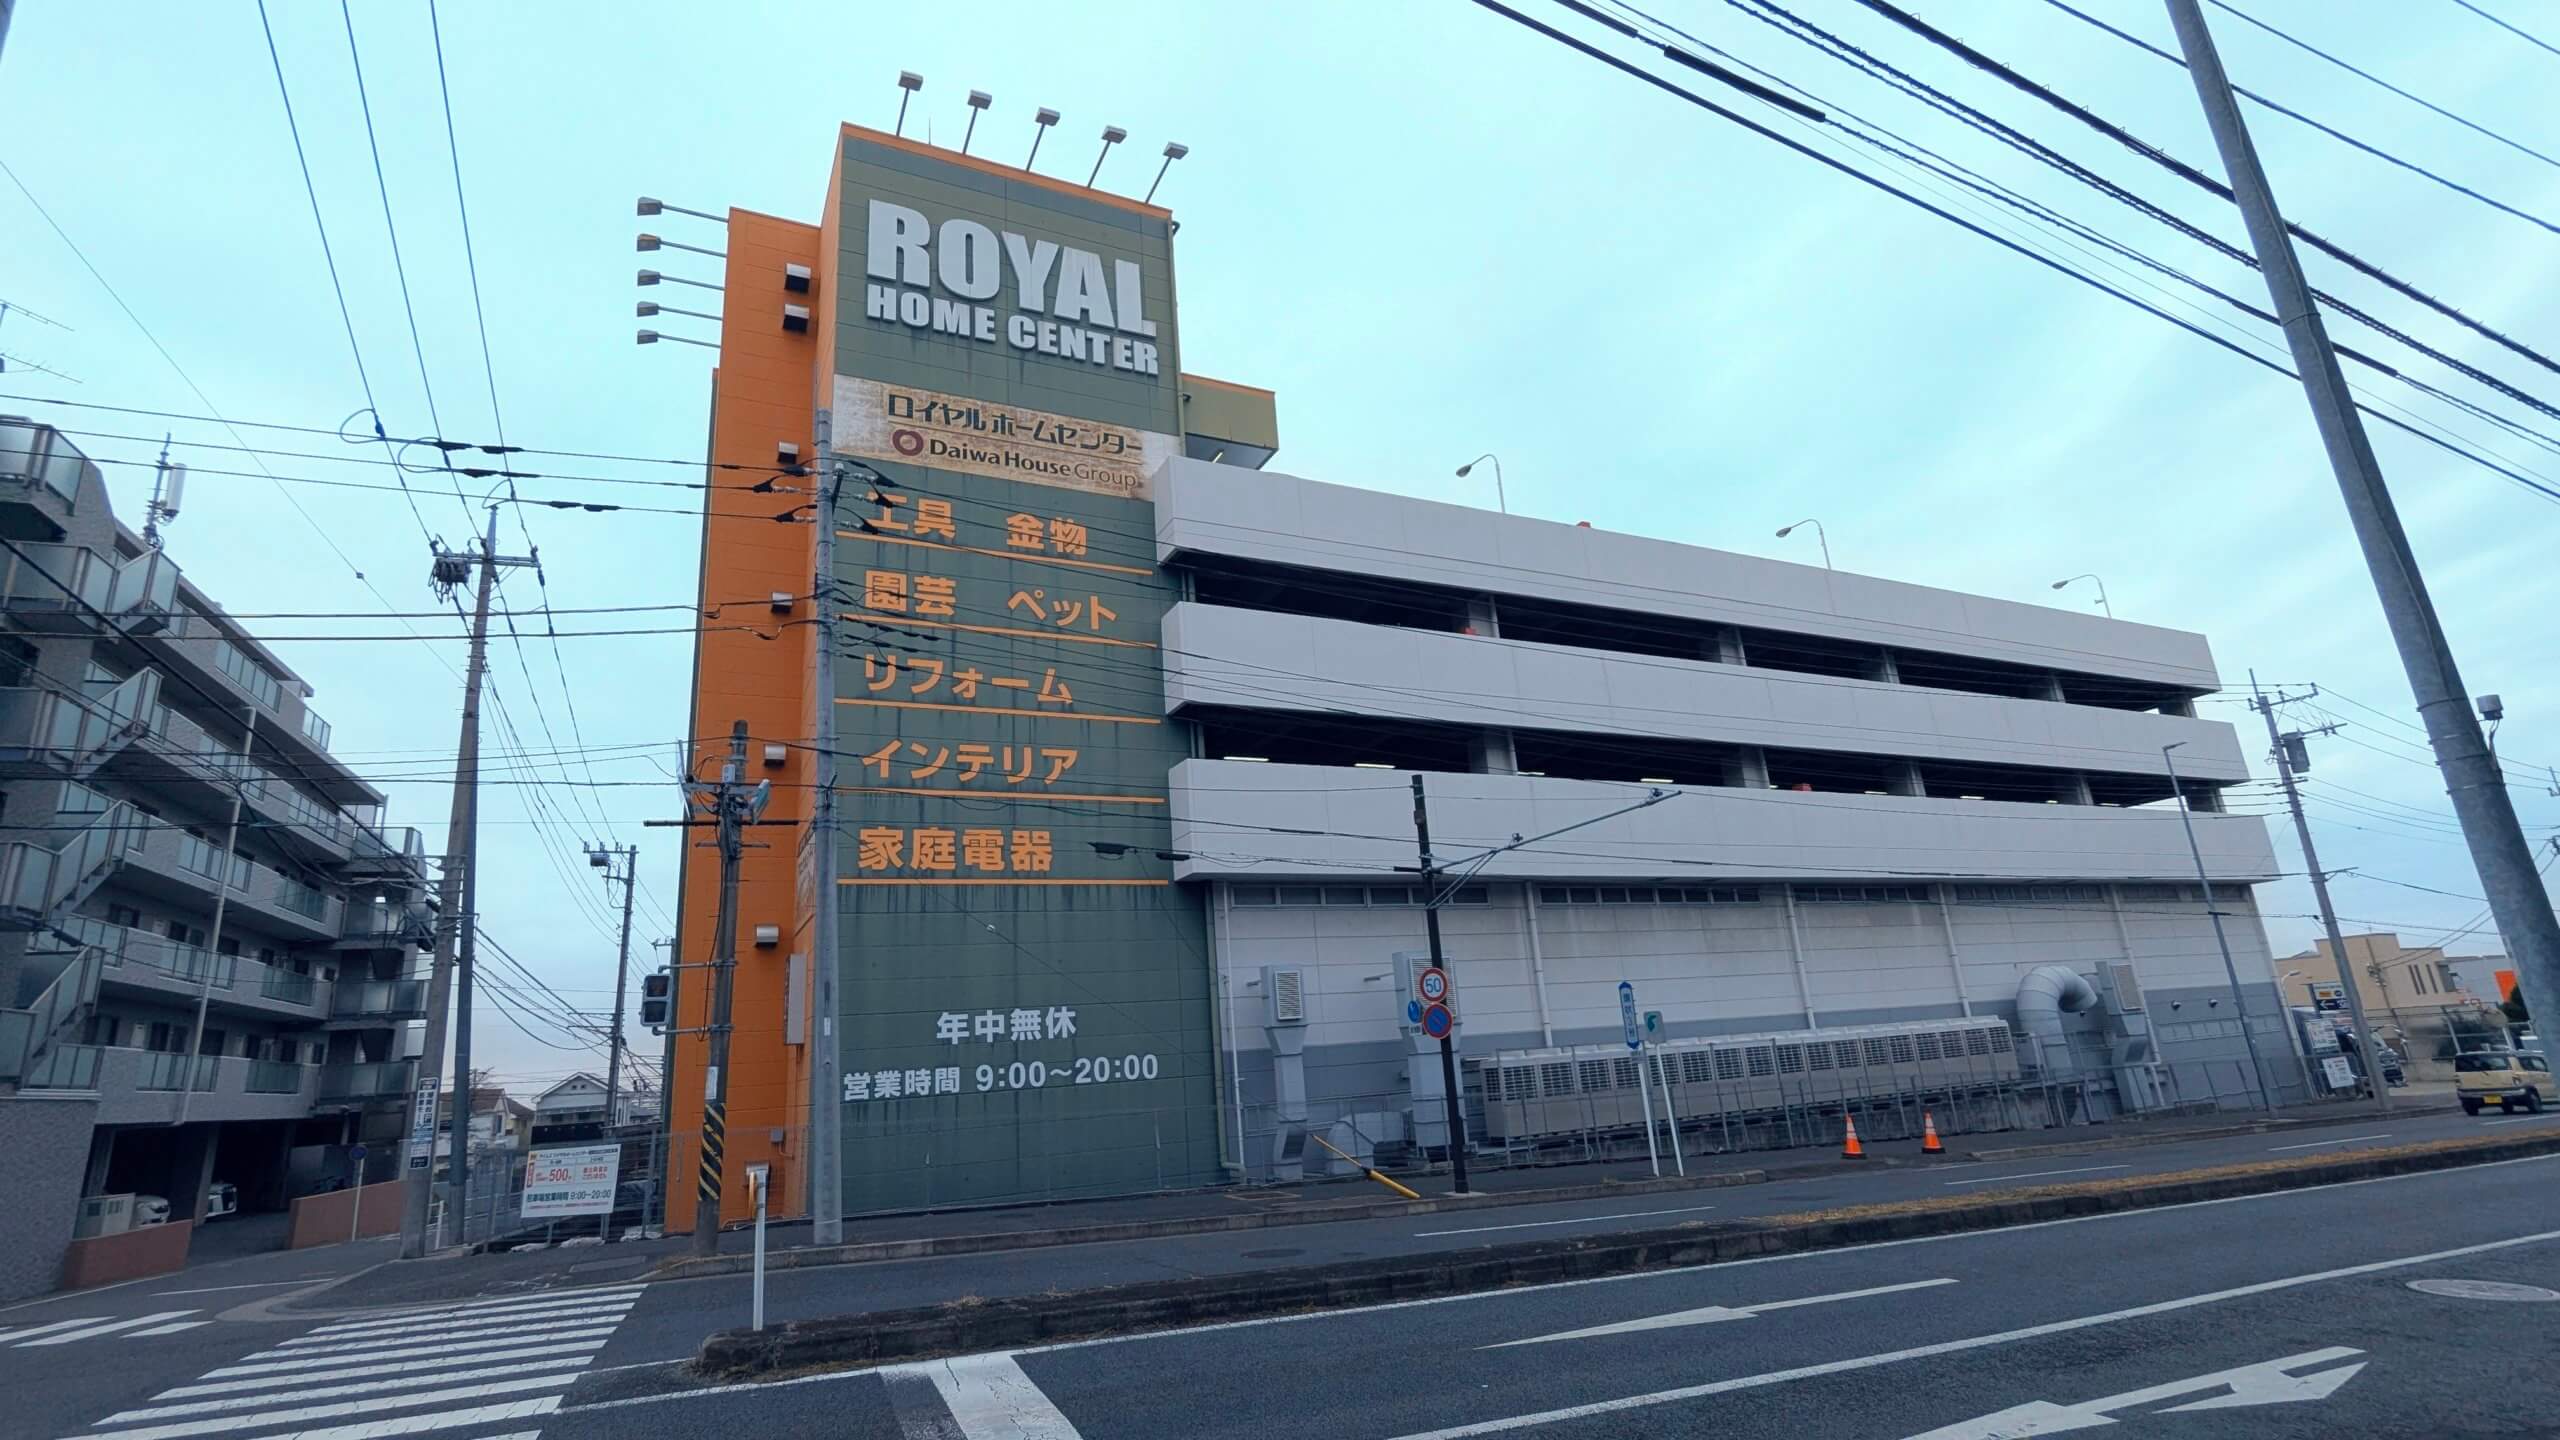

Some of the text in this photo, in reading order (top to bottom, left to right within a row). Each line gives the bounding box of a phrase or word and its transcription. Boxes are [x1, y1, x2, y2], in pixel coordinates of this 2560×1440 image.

[867, 199, 1156, 337] ROYAL
[867, 283, 1158, 375] HOME CENTER
[889, 394, 1143, 454] ロイヤルホームセンター
[929, 439, 1137, 491] Daiwa House Group
[866, 491, 1087, 555] 工具 金物
[864, 570, 1117, 631] 園芸 ペット
[865, 654, 1073, 705] リフォーム
[861, 739, 1078, 785] インテリア
[858, 826, 1053, 872] 家庭電器
[1425, 977, 1442, 993] 50
[936, 1006, 1077, 1045] 年中無休
[844, 1066, 961, 1101] 営業時間
